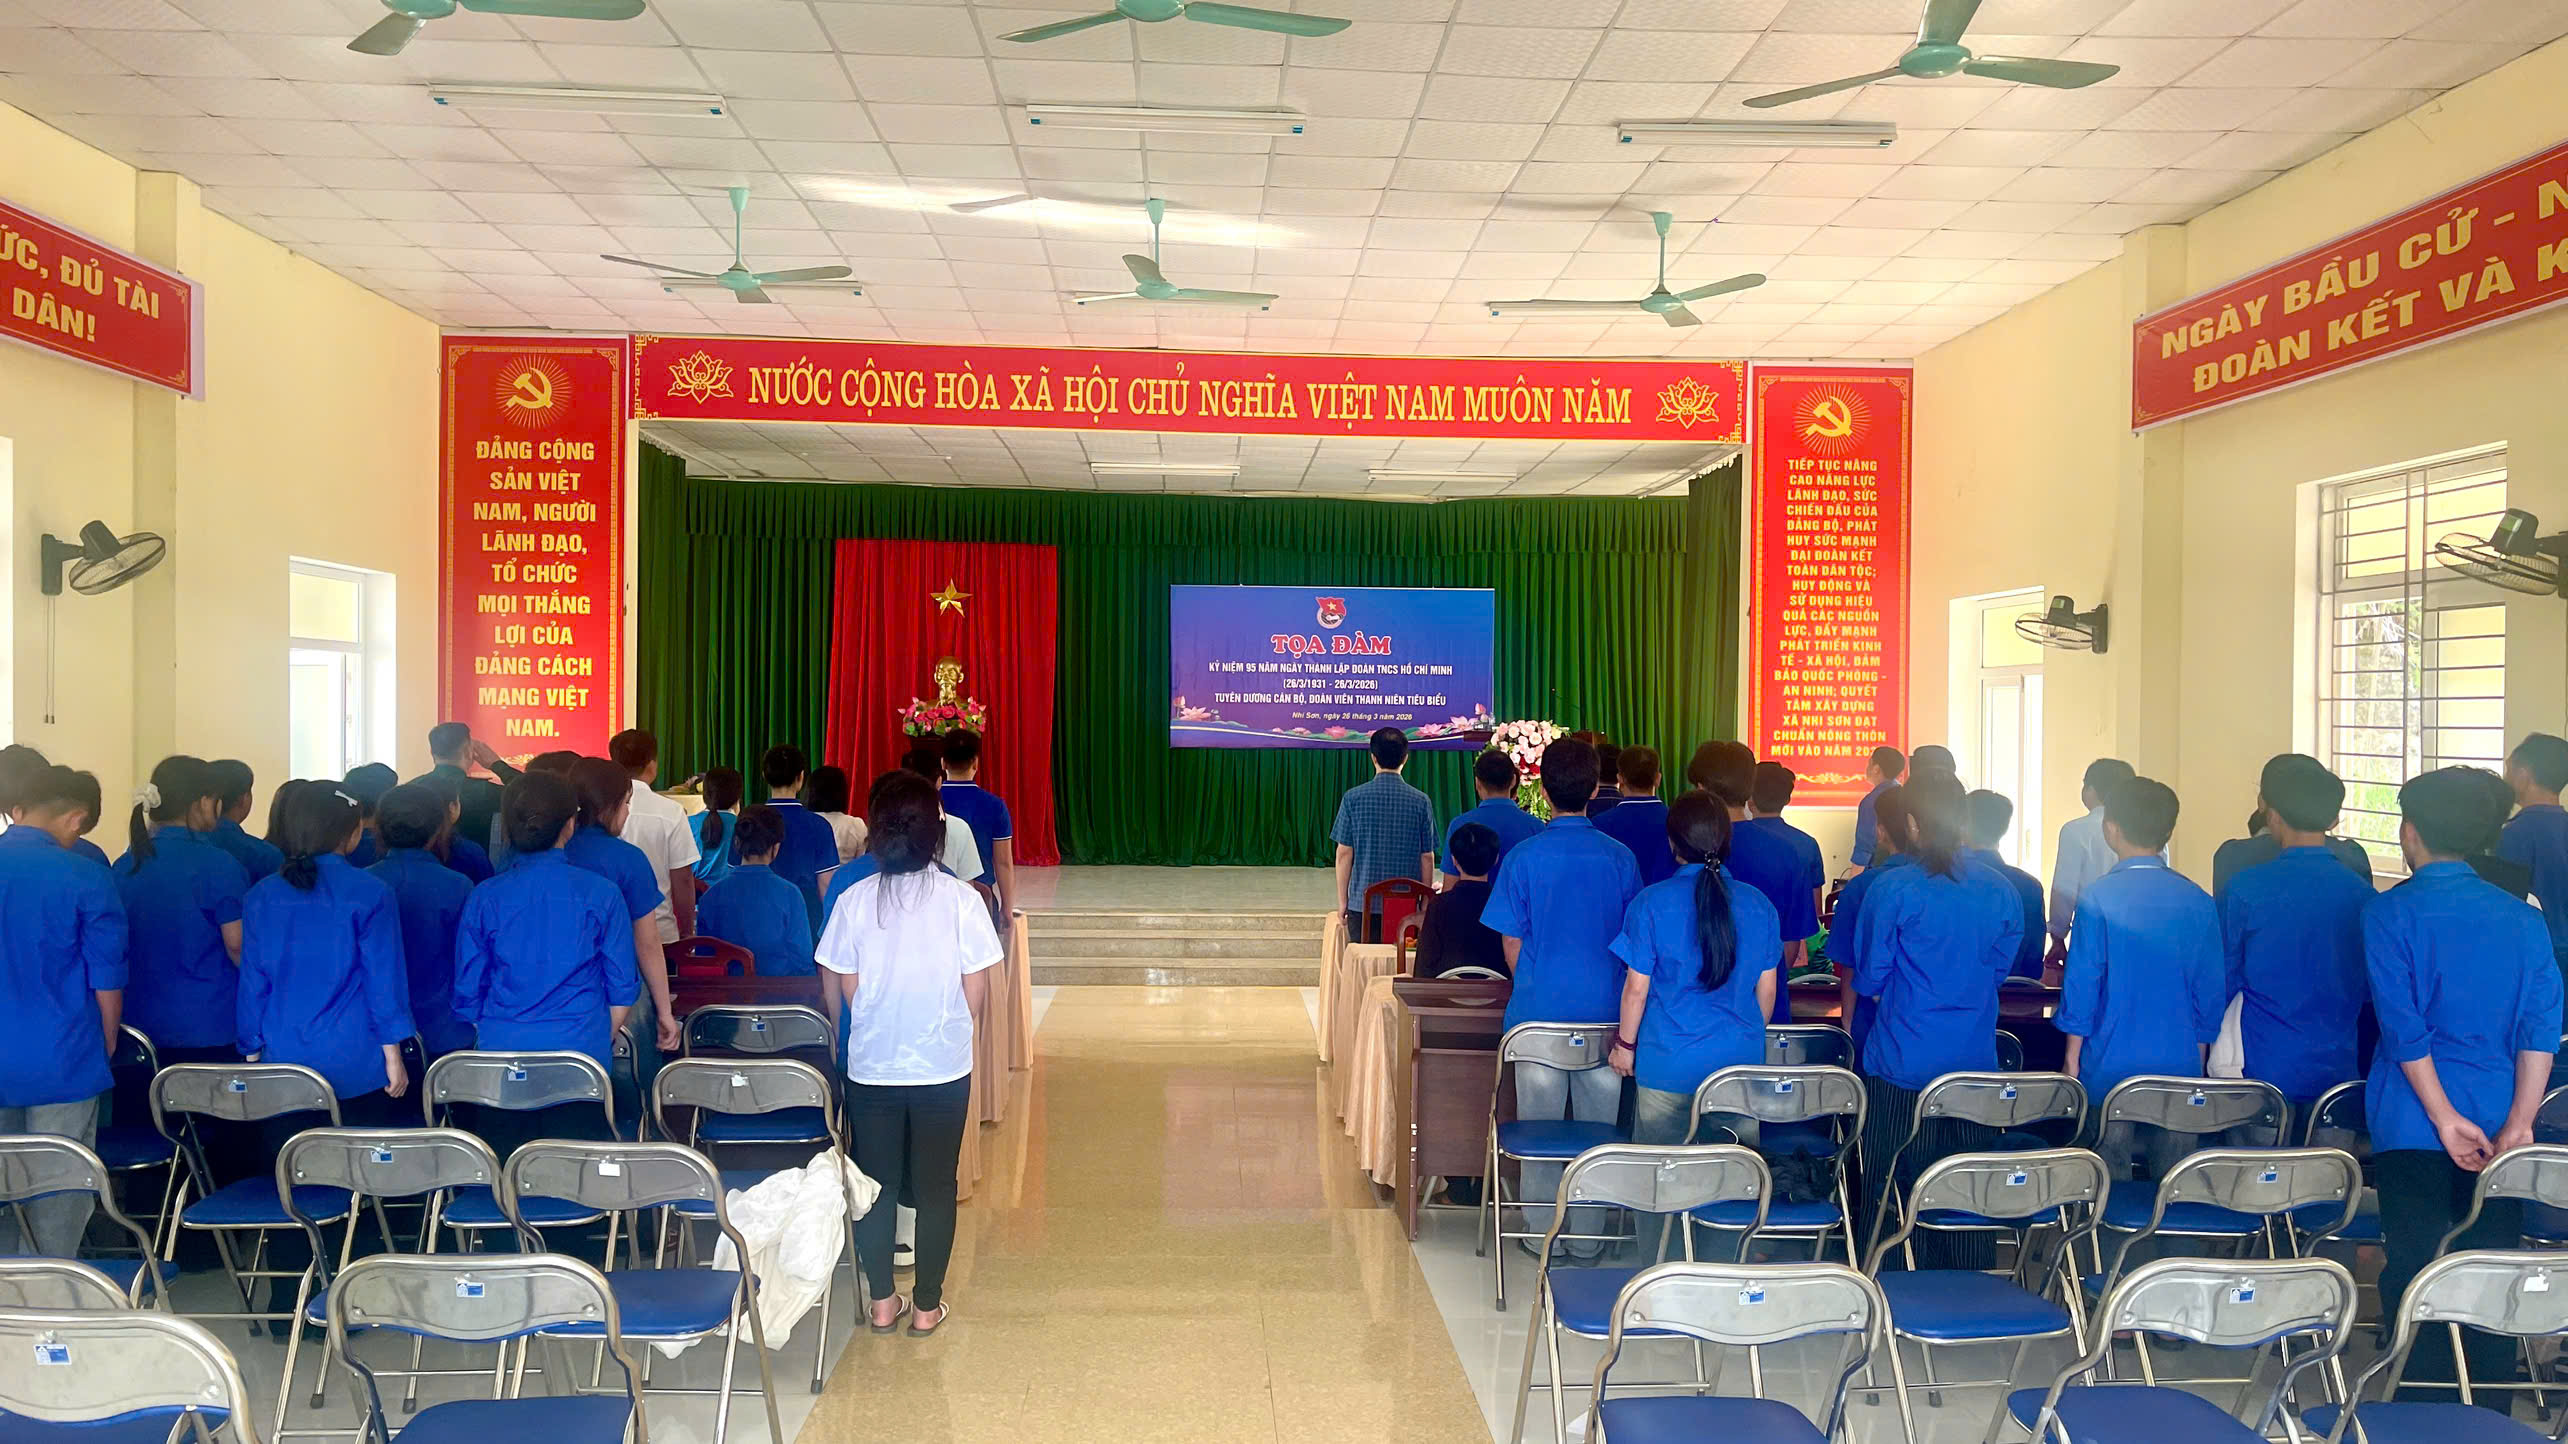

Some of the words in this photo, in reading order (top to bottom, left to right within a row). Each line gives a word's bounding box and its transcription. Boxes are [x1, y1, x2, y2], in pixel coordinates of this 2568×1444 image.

[60, 255, 103, 296] ĐỦ
[114, 276, 159, 319] TÀI
[2162, 295, 2268, 359] NGÀY
[2284, 251, 2379, 315] BẦU
[2398, 207, 2479, 270] CỬ
[13, 287, 95, 342] DÂN!
[2193, 329, 2310, 393] ĐOÀN
[2328, 289, 2421, 351] KẾT
[2438, 256, 2515, 313] VÀ
[749, 355, 831, 405] NƯỚC
[841, 358, 926, 417] CỘNG
[935, 360, 1000, 410] HÒA
[1010, 365, 1054, 411] XÃ
[1064, 364, 1118, 423] HỘI
[1128, 362, 1189, 416] CHỦ
[1199, 373, 1297, 419] NGHĨA
[1307, 372, 1377, 430] VIỆT
[1385, 385, 1455, 421] NAM
[1463, 375, 1554, 423] MUÔN
[1562, 378, 1632, 424] NĂM
[475, 435, 532, 460] ĐẢNG
[539, 439, 594, 463] CỘNG
[490, 466, 531, 490] SẢN
[539, 469, 580, 494] VIỆT
[473, 503, 527, 523] NAM,
[534, 500, 596, 521] NGƯỜI
[482, 530, 535, 552] LÃNH
[541, 534, 587, 557] ĐẠO,
[492, 558, 517, 583] TỔ
[523, 561, 576, 583] CHỨC
[478, 595, 517, 617] MỌI
[523, 589, 590, 615] THẮNG
[495, 624, 525, 648] LỢI
[532, 620, 573, 645] CỦA
[1271, 634, 1326, 658] TỌA
[1331, 630, 1392, 655] ĐÀM
[475, 651, 531, 675] ĐẢNG
[537, 653, 592, 676] CÁCH
[1222, 661, 1244, 674] NIỆM
[1246, 662, 1256, 672] 95
[1258, 661, 1278, 673] NĂM
[1280, 662, 1302, 673] NGÀY
[1304, 662, 1332, 673] THÀNH
[1334, 662, 1350, 675] LẬP
[1377, 664, 1398, 675] TNCS
[1414, 663, 1428, 675] CHÍ
[1430, 665, 1453, 675] MINH
[478, 688, 539, 710] MẠNG
[546, 686, 588, 710] VIỆT
[1215, 691, 1241, 703] TUYÊN
[1243, 693, 1272, 703] DƯƠNG
[1274, 692, 1291, 704] CÁN
[1293, 692, 1307, 705] BỘ,
[1309, 692, 1332, 704] ĐOÀN
[1334, 692, 1353, 704] VIÊN
[1355, 694, 1383, 705] THANH
[1384, 693, 1405, 705] NIÊN
[1407, 693, 1425, 705] TIÊU
[1427, 692, 1446, 706] BIỂU
[1283, 679, 1326, 689] (26/3/1931
[1334, 680, 1378, 690] 26/3/2026)
[506, 719, 560, 736] NAM.
